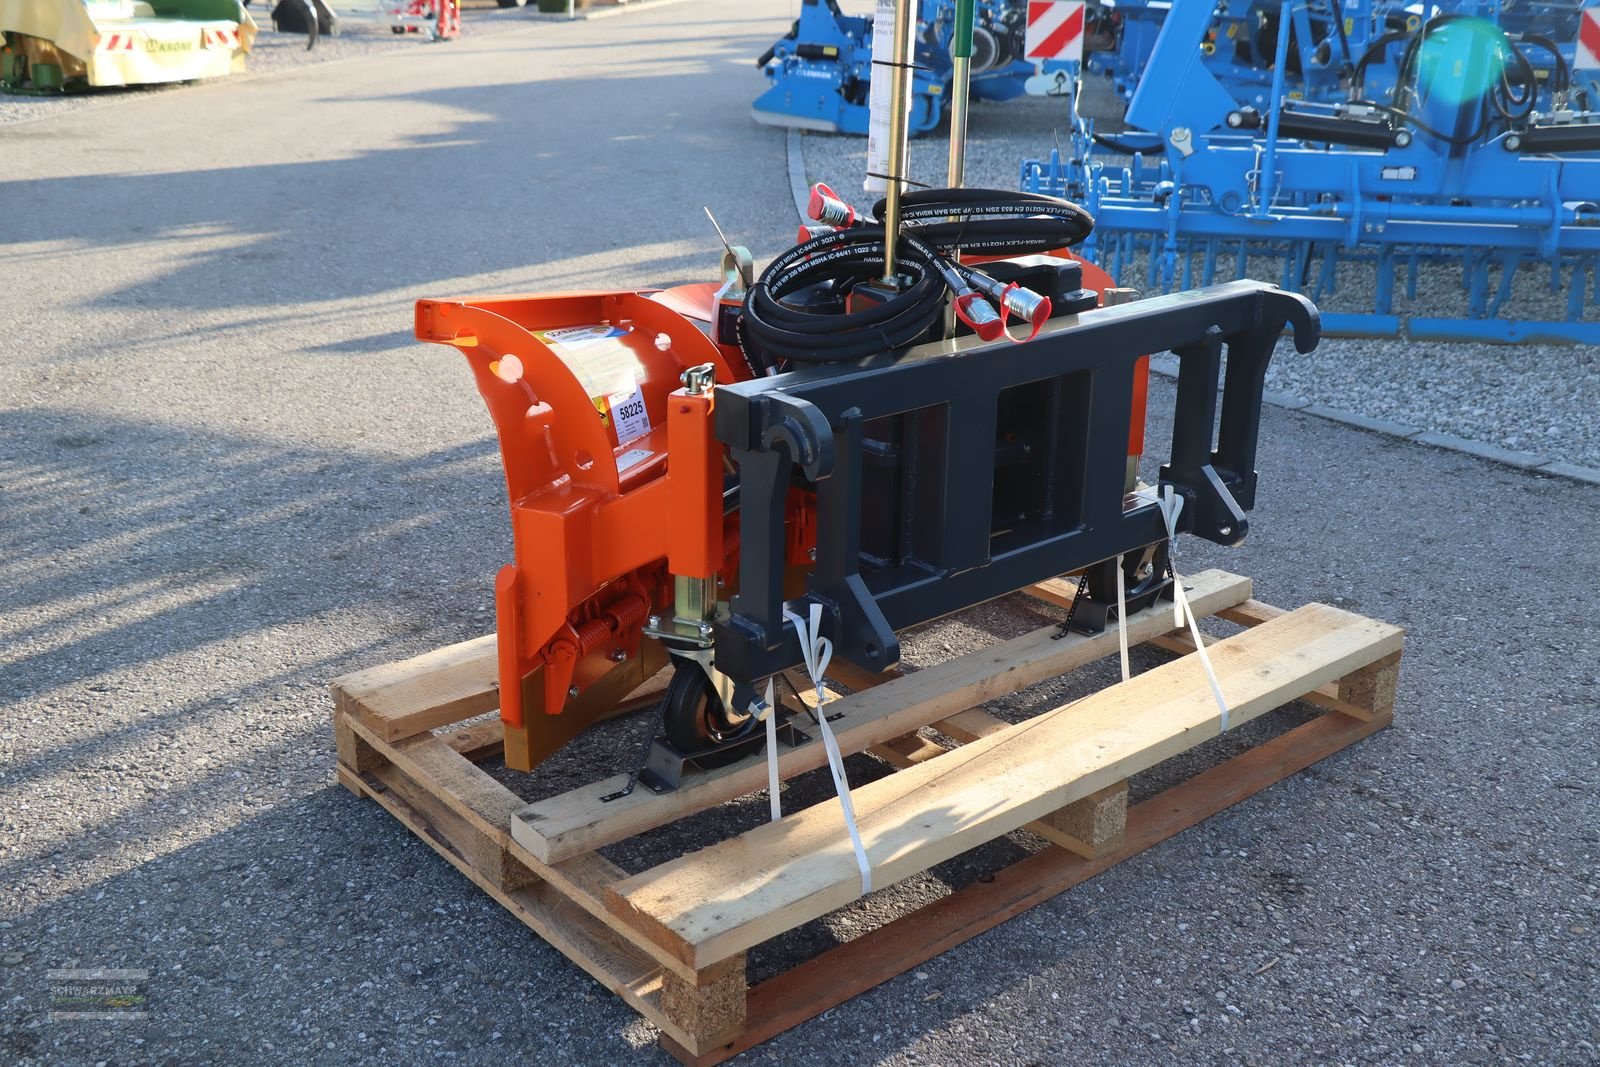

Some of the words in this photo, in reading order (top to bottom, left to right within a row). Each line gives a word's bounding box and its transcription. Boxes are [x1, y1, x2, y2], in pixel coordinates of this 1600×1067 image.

[908, 238, 935, 260] HANSA-FLE
[774, 260, 785, 271] BAR
[783, 251, 798, 263] MSHA
[797, 262, 810, 273] BAR
[810, 256, 828, 267] MSHA
[620, 400, 643, 420] 58225
